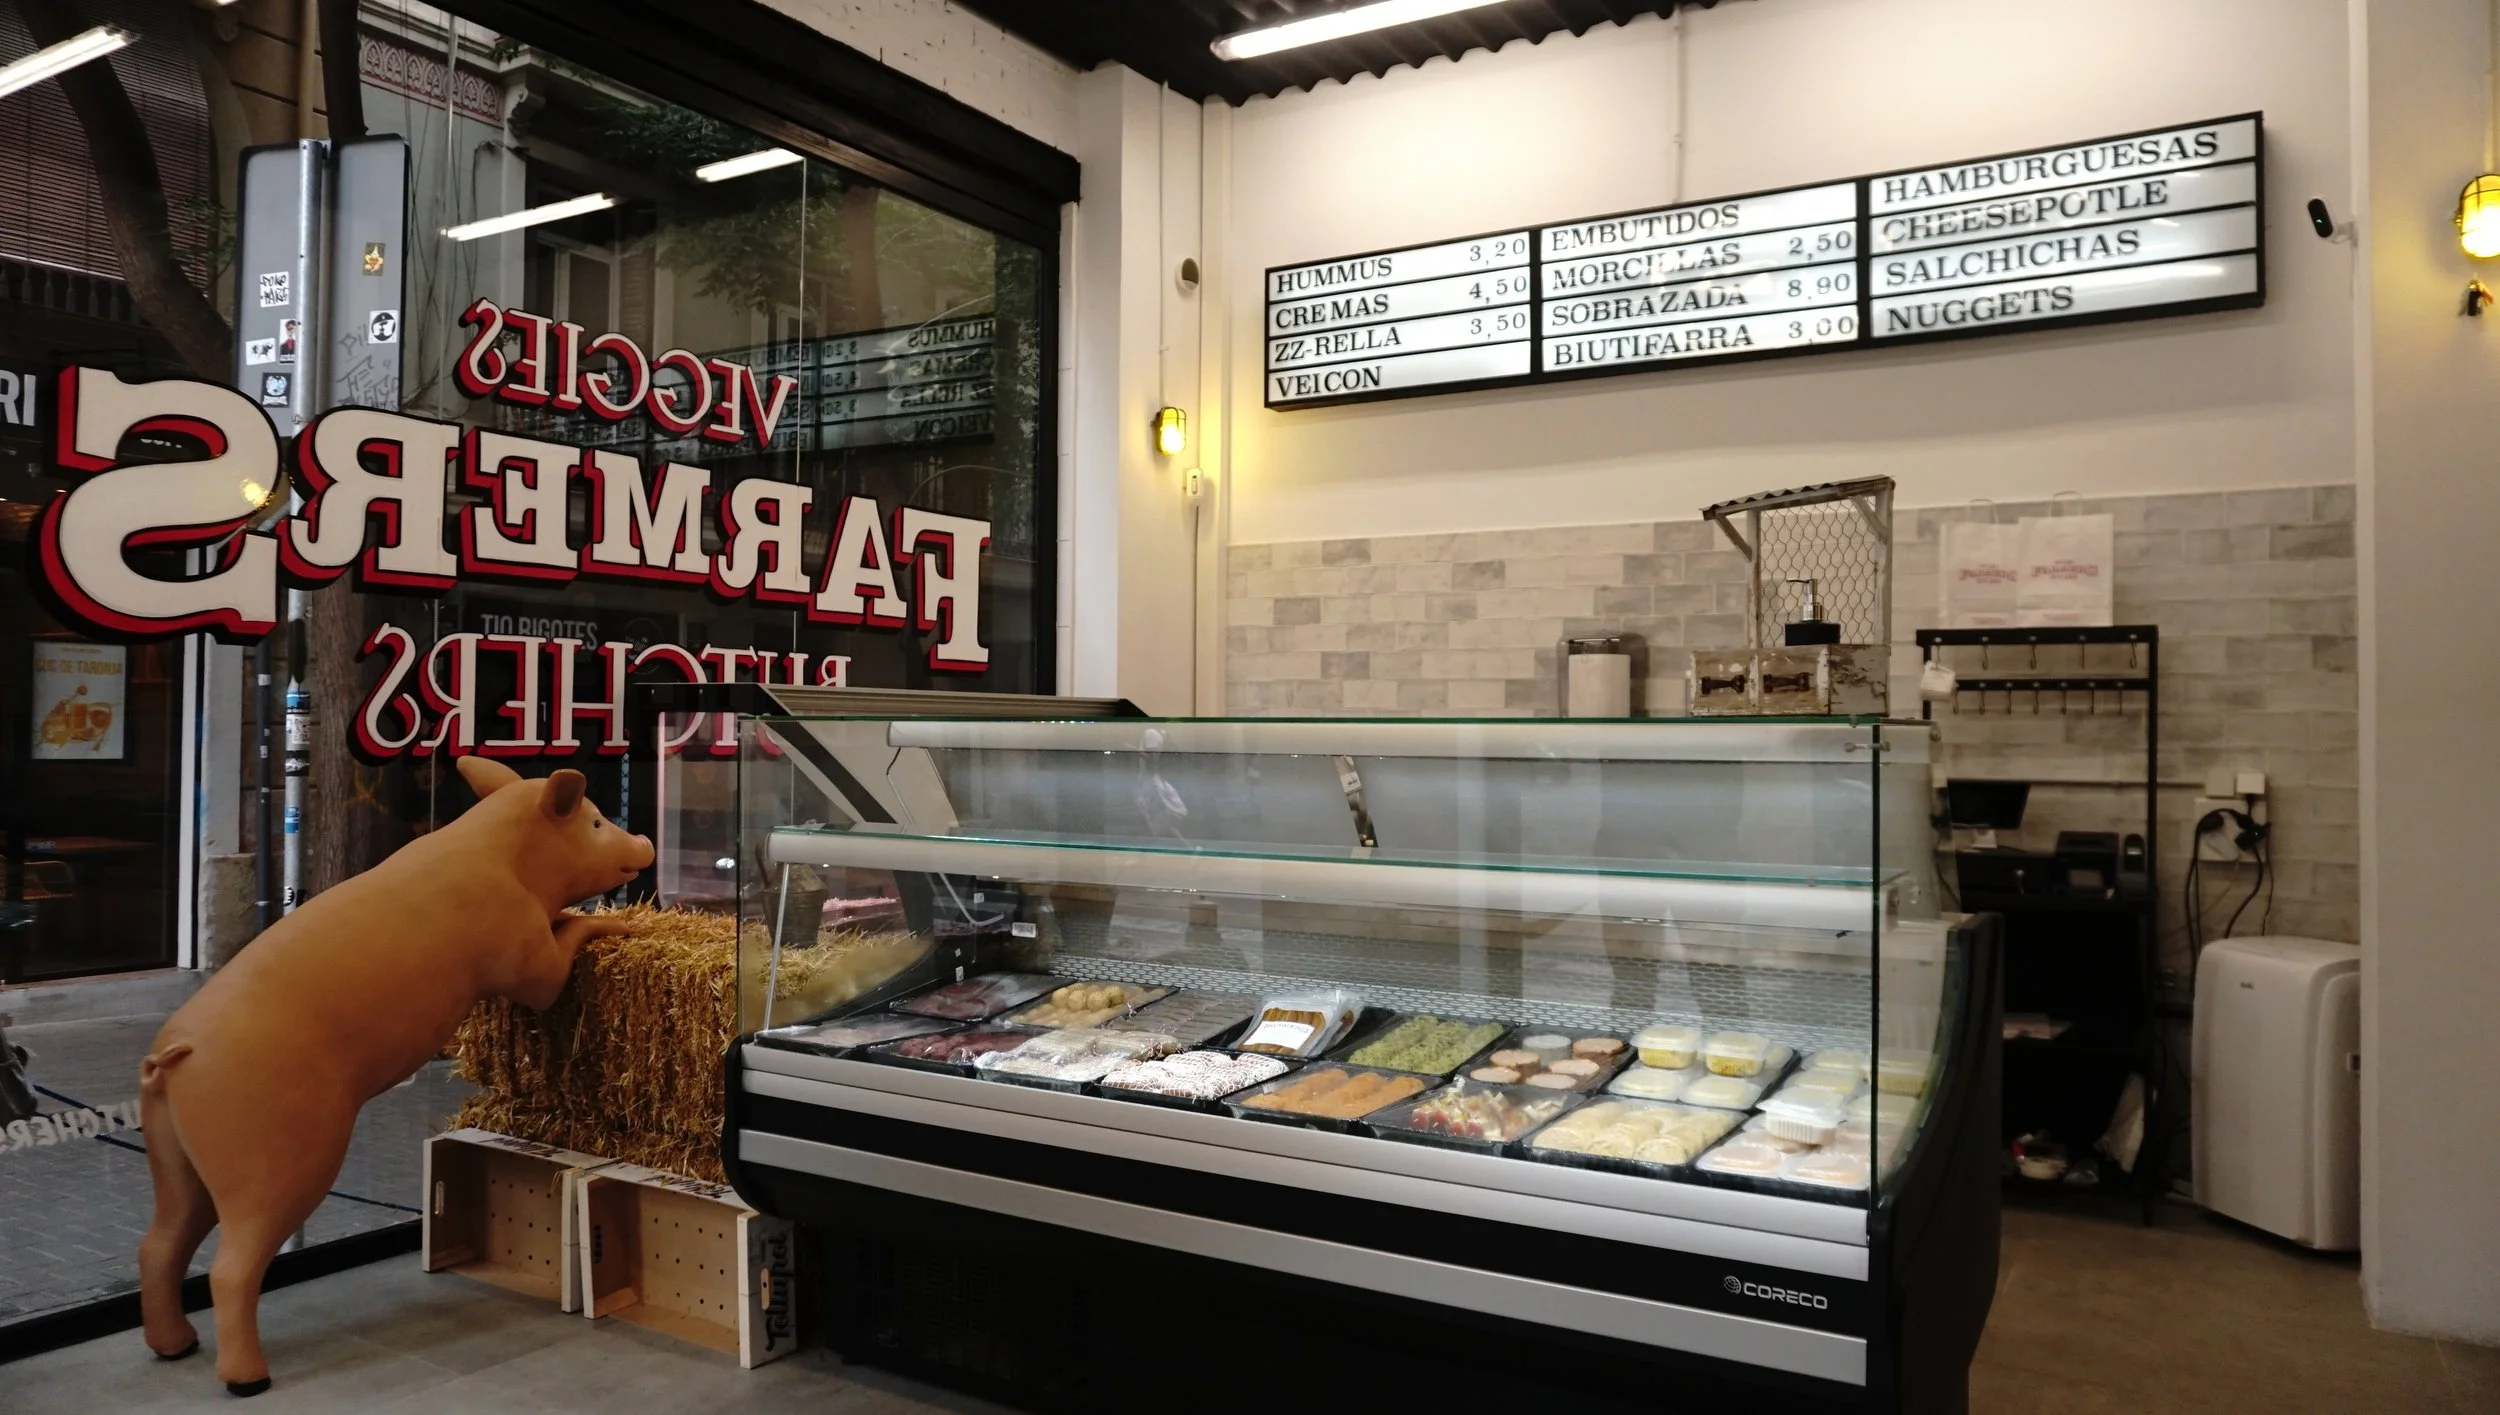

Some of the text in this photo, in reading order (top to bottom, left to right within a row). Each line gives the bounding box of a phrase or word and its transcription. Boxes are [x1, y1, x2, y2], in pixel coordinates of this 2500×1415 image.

[1882, 130, 2220, 203] HAMBURGUESAS
[1551, 203, 1741, 252] EMBUTIDOS
[1882, 178, 2169, 245] CHEESEPOTLE
[1276, 256, 1393, 294] HUMMUS
[1552, 242, 1741, 291] MORCILLAS
[1885, 228, 2140, 288] SALCHICHAS
[1275, 292, 1390, 330] CREMAS
[1552, 283, 1748, 327] SOBRAZADA
[1885, 284, 2075, 333] NUGGETS
[1275, 325, 1402, 363] ZZ-RELLA
[1553, 323, 1755, 366] BIUTIFARRA
[1275, 365, 1383, 398] VEICON
[1743, 1282, 1828, 1310] CORECO
